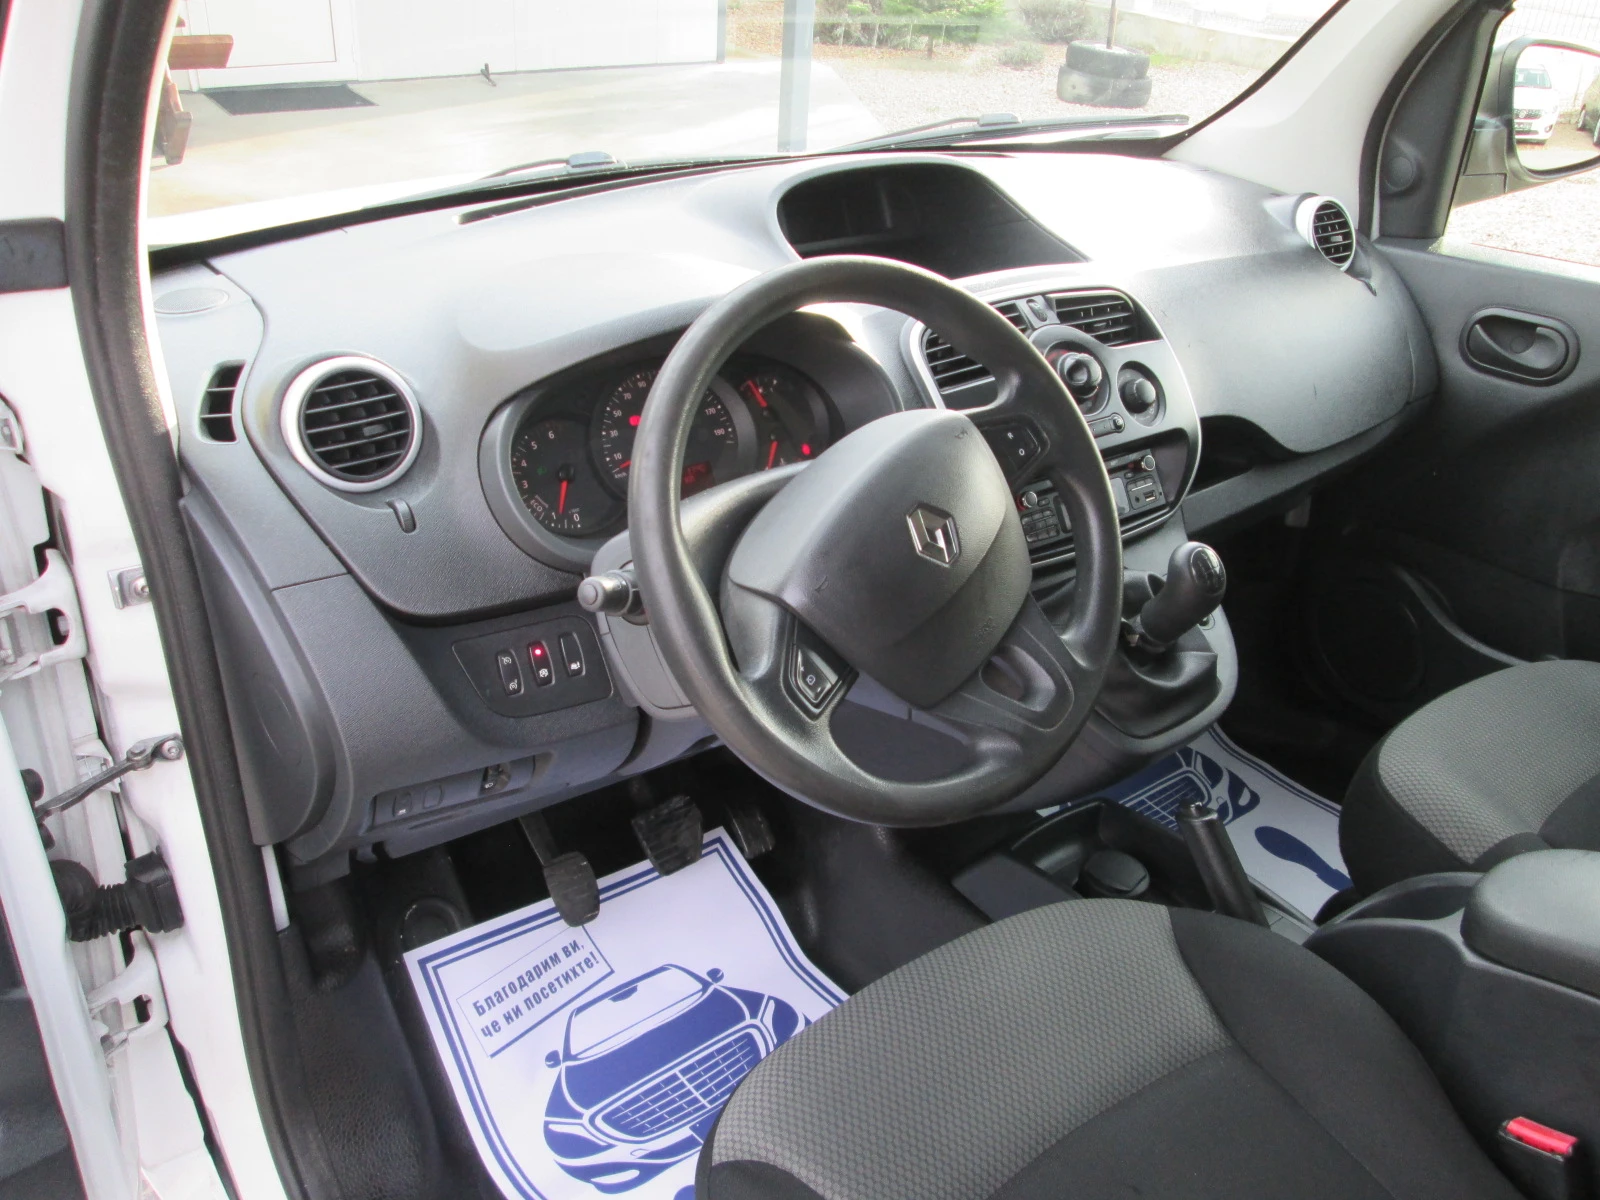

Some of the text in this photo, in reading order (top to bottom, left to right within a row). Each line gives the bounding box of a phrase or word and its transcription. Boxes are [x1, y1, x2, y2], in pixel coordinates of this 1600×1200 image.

[613, 409, 622, 418] 50
[548, 430, 555, 439] 6
[531, 441, 538, 450] 5
[613, 452, 622, 460] 10
[521, 459, 528, 467] 4
[521, 480, 529, 489] 3
[530, 499, 543, 512] ECO
[573, 513, 580, 522] 0
[472, 939, 585, 1017] Благодарим ви,
[480, 951, 599, 1038] че ни посетихте!
